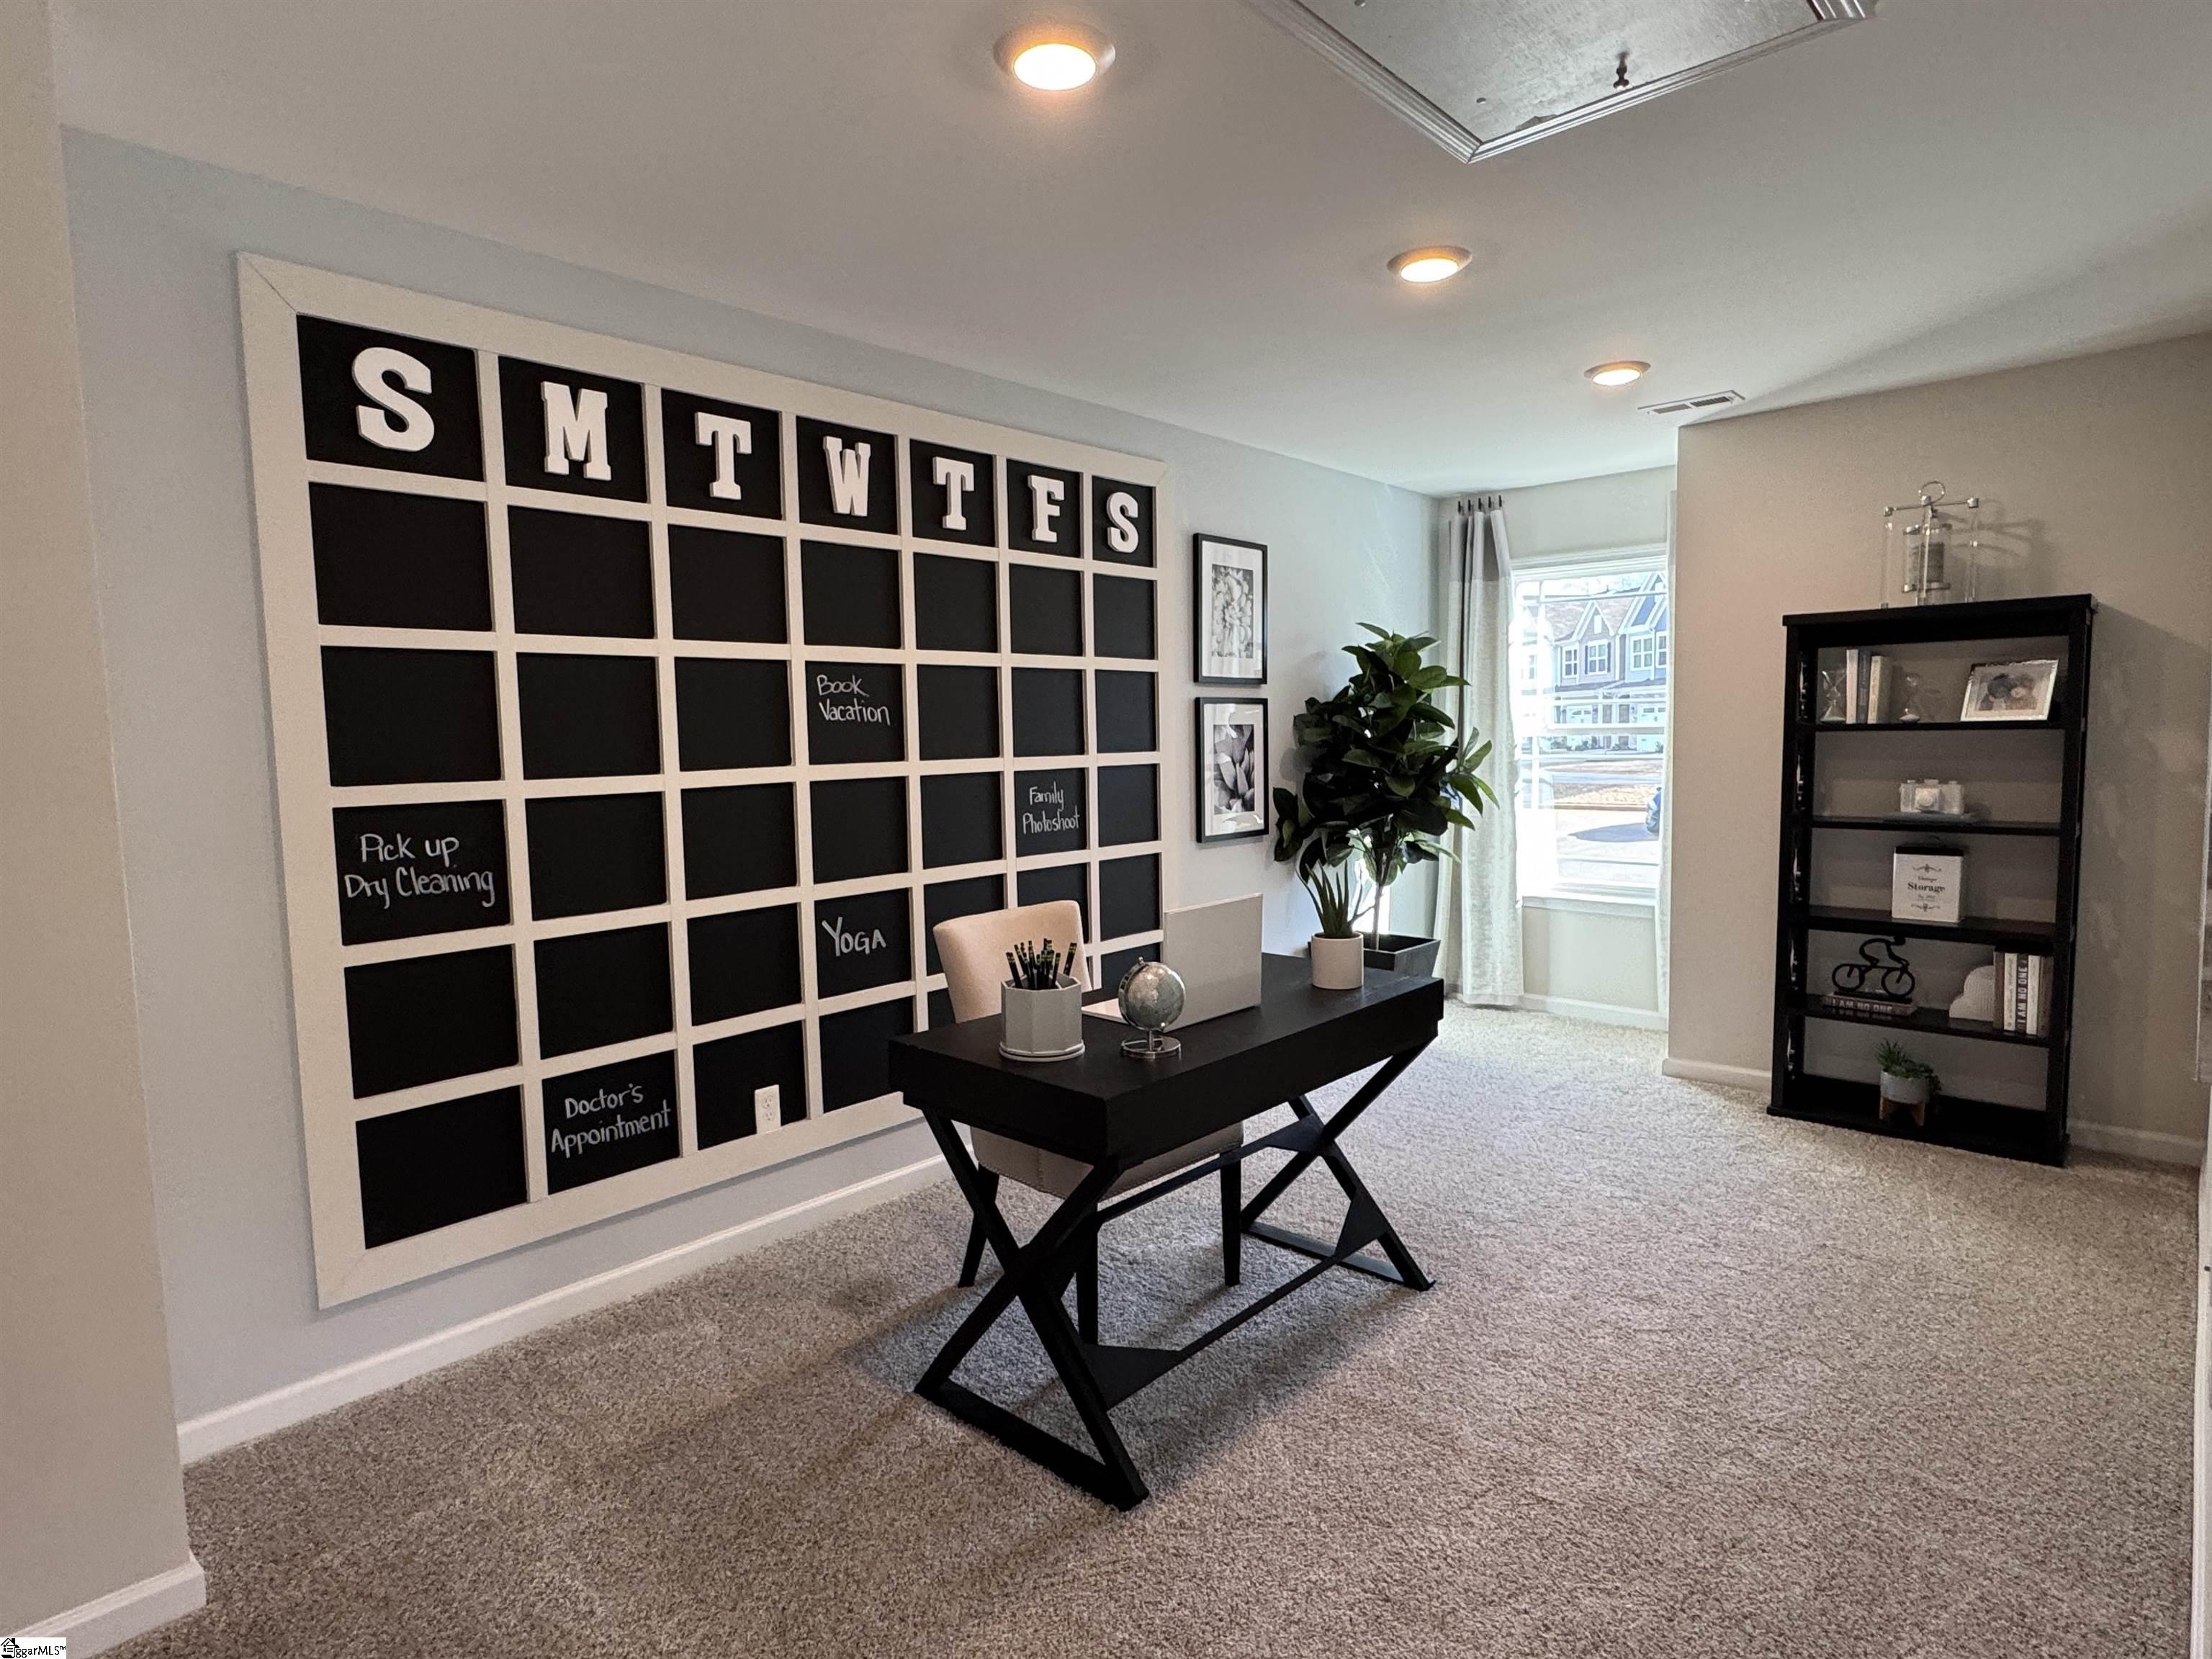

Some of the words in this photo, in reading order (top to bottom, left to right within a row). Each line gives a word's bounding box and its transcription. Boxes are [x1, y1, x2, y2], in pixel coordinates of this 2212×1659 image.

[351, 347, 435, 451] S
[541, 381, 611, 481] M
[695, 412, 752, 500] T
[823, 436, 871, 517] W
[932, 457, 974, 531] T
[1027, 475, 1065, 543] F
[1106, 492, 1139, 553] S
[817, 674, 870, 697] Book
[819, 698, 891, 726] Vacation
[1030, 781, 1064, 811] Family
[1022, 804, 1080, 835] Photoshoot
[360, 833, 415, 863] Pick
[426, 837, 459, 868] up
[344, 874, 390, 909] Dry
[396, 866, 495, 907] Cleaning
[2018, 966, 2028, 985] ONE
[1839, 999, 1854, 1010] AM
[1857, 1002, 1871, 1012] NO
[1873, 1004, 1893, 1013] ONE
[2017, 987, 2028, 1000] NO
[2017, 1002, 2027, 1017] AM
[565, 1083, 644, 1119] Doctor's
[551, 1099, 671, 1159] Appointment
